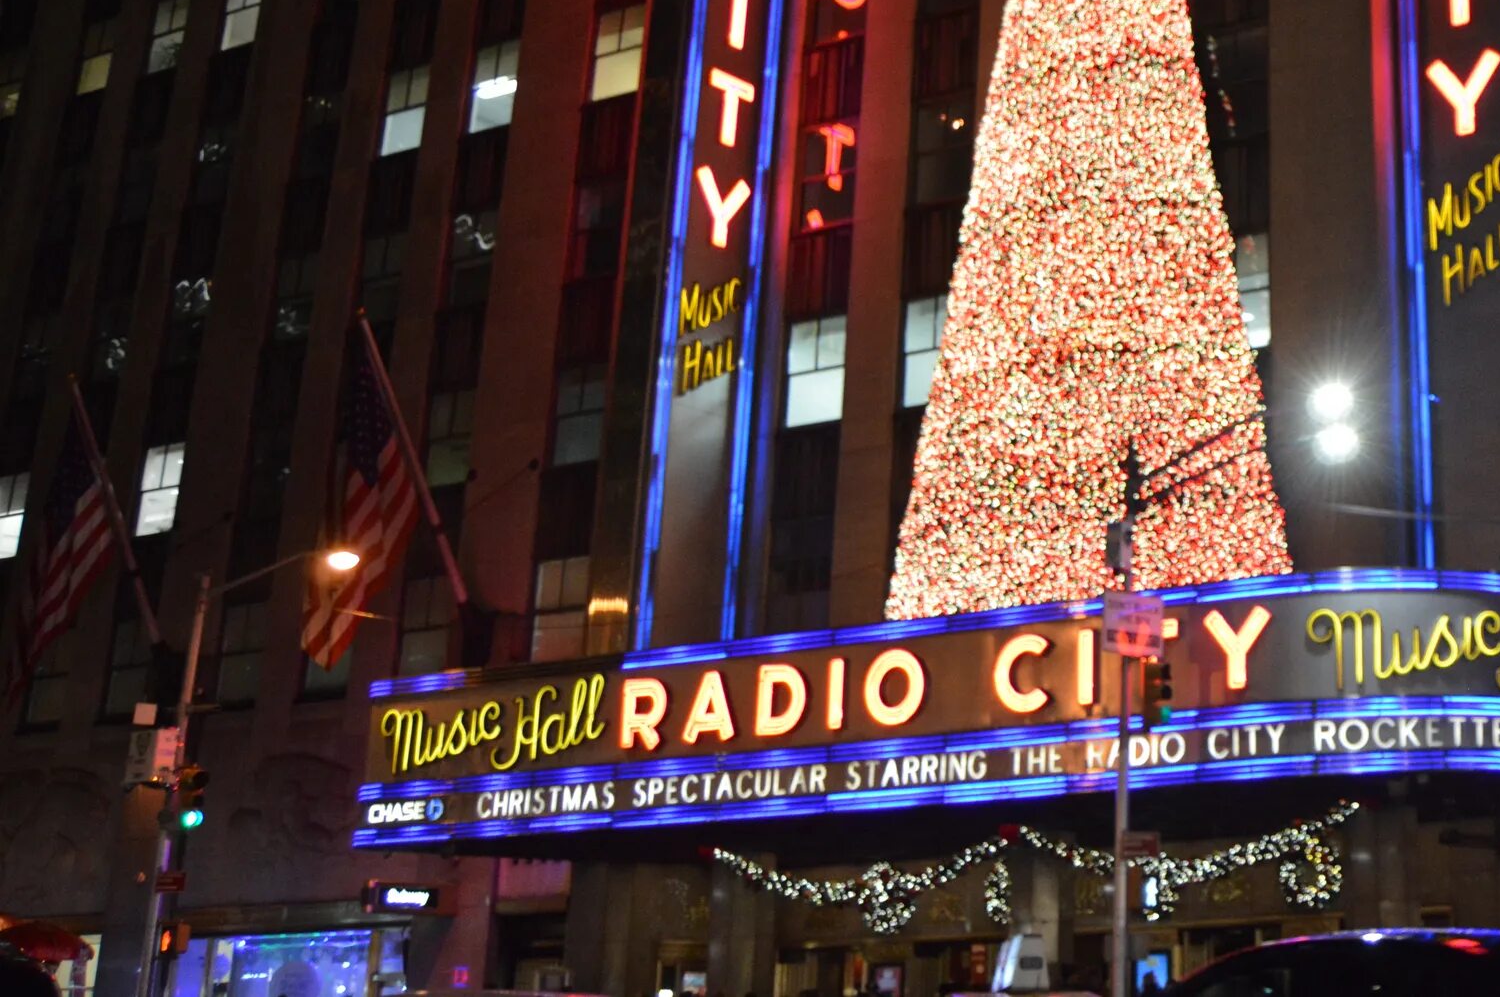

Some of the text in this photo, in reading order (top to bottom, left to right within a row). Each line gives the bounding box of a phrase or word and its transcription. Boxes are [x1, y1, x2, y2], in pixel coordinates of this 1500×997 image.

[682, 338, 735, 393] HALL
[620, 648, 926, 752] RADIO
[993, 605, 1272, 713] CIY
[381, 673, 607, 774] Music Hall
[476, 782, 615, 820] CHRISTMAS
[632, 764, 827, 806] SPECTACULAR
[845, 750, 988, 790] STARRING
[1009, 744, 1063, 775] THE
[1207, 723, 1286, 760] CITY
[368, 801, 426, 824] CHASE
